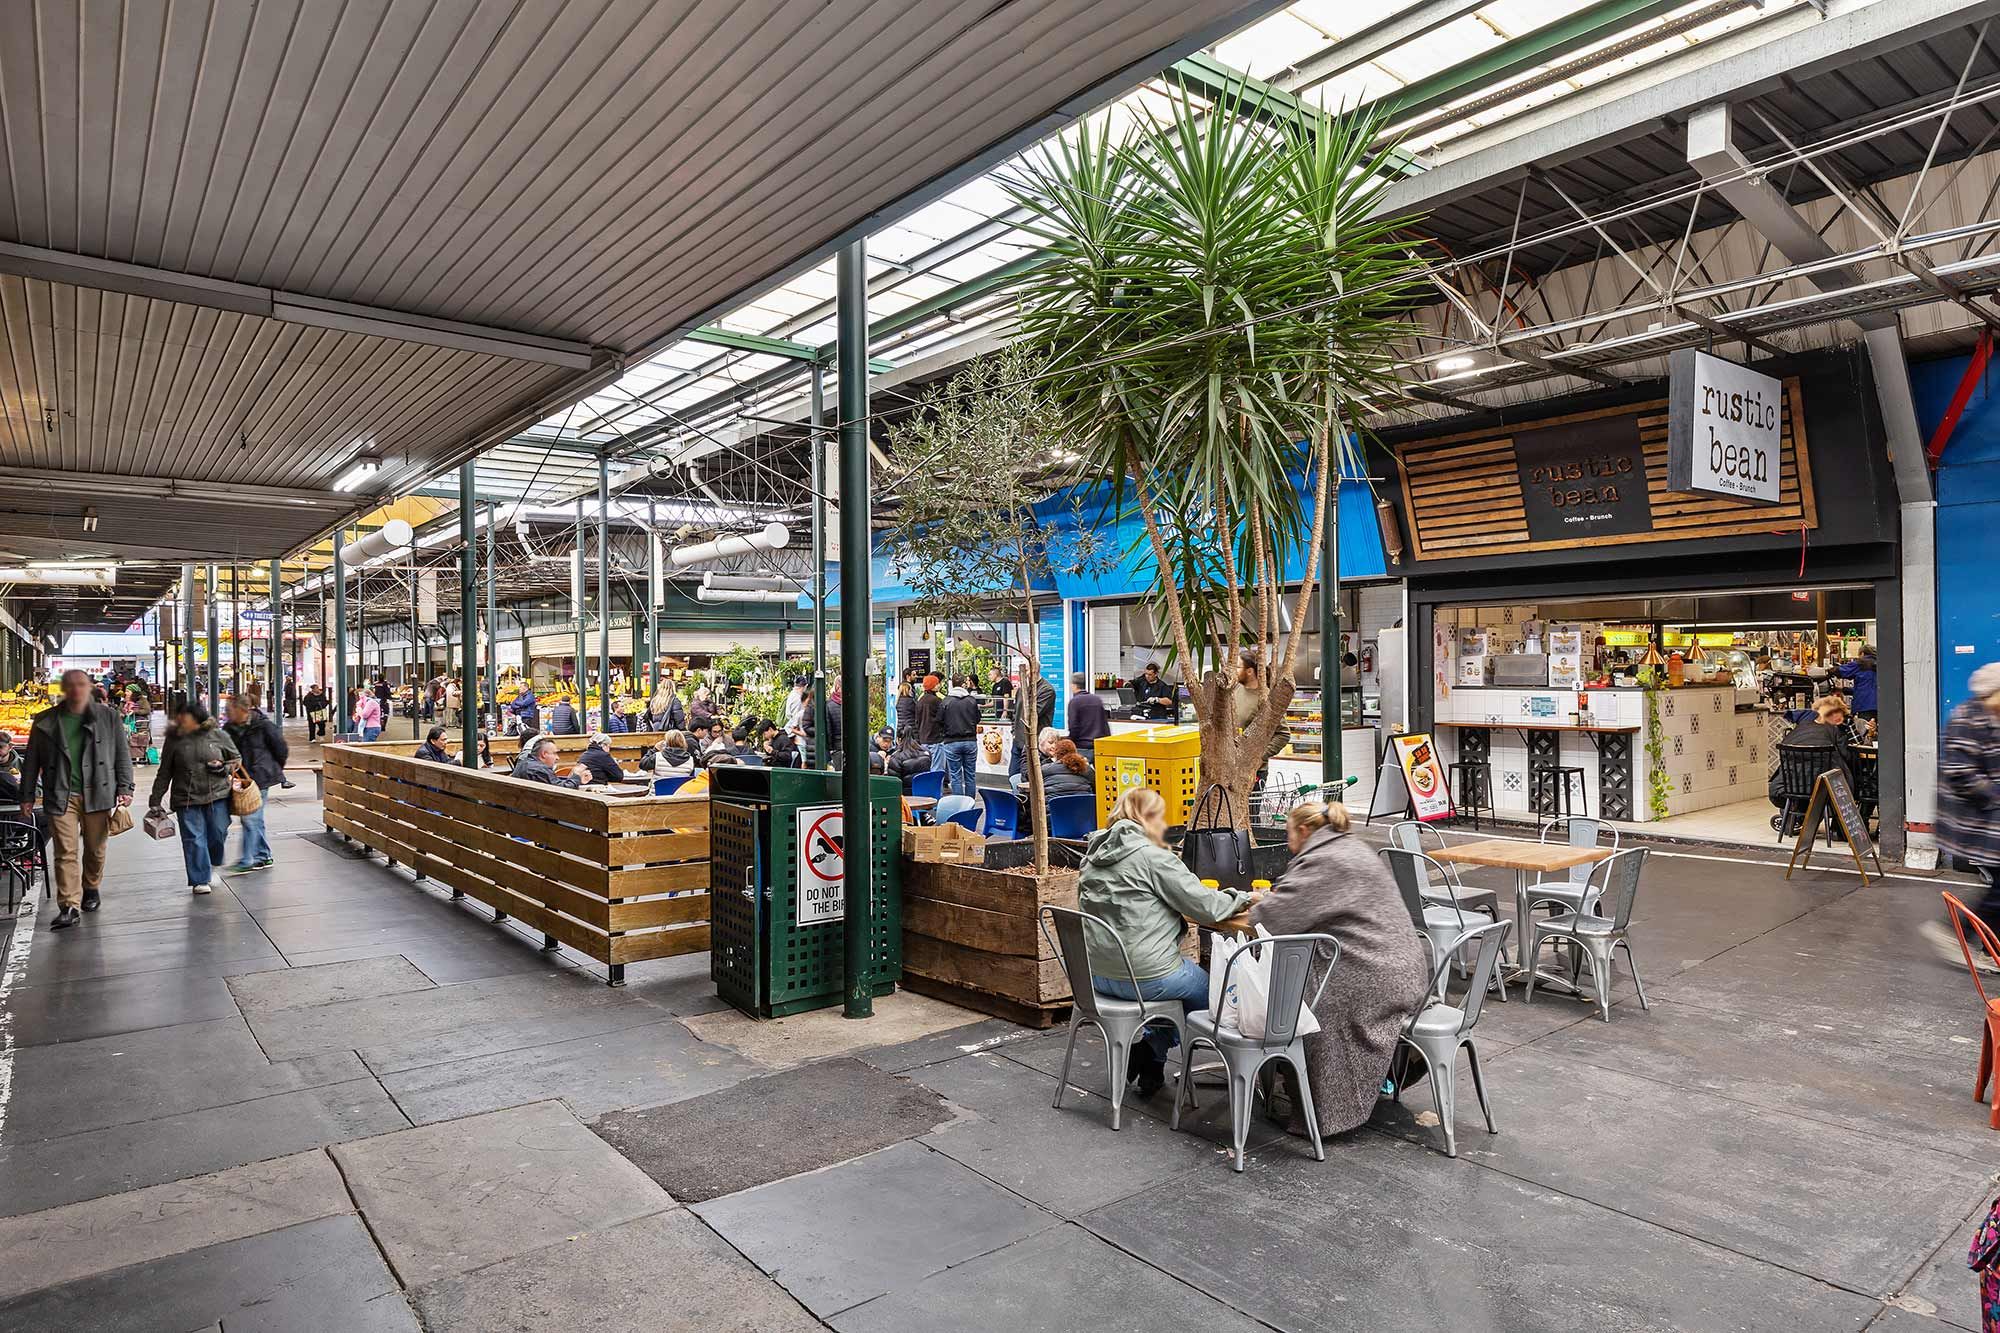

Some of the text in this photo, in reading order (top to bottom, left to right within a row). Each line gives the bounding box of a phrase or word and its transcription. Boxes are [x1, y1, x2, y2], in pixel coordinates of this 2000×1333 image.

[1702, 385, 1775, 431] rustic
[1709, 425, 1767, 482] bean
[1529, 454, 1633, 484] rustic
[1719, 477, 1735, 489] Coffee
[1739, 481, 1756, 493] Brunch
[1548, 485, 1621, 508] bean
[1590, 513, 1613, 521] Brunch
[807, 885, 840, 901] DO NOT
[812, 900, 830, 914] THE
